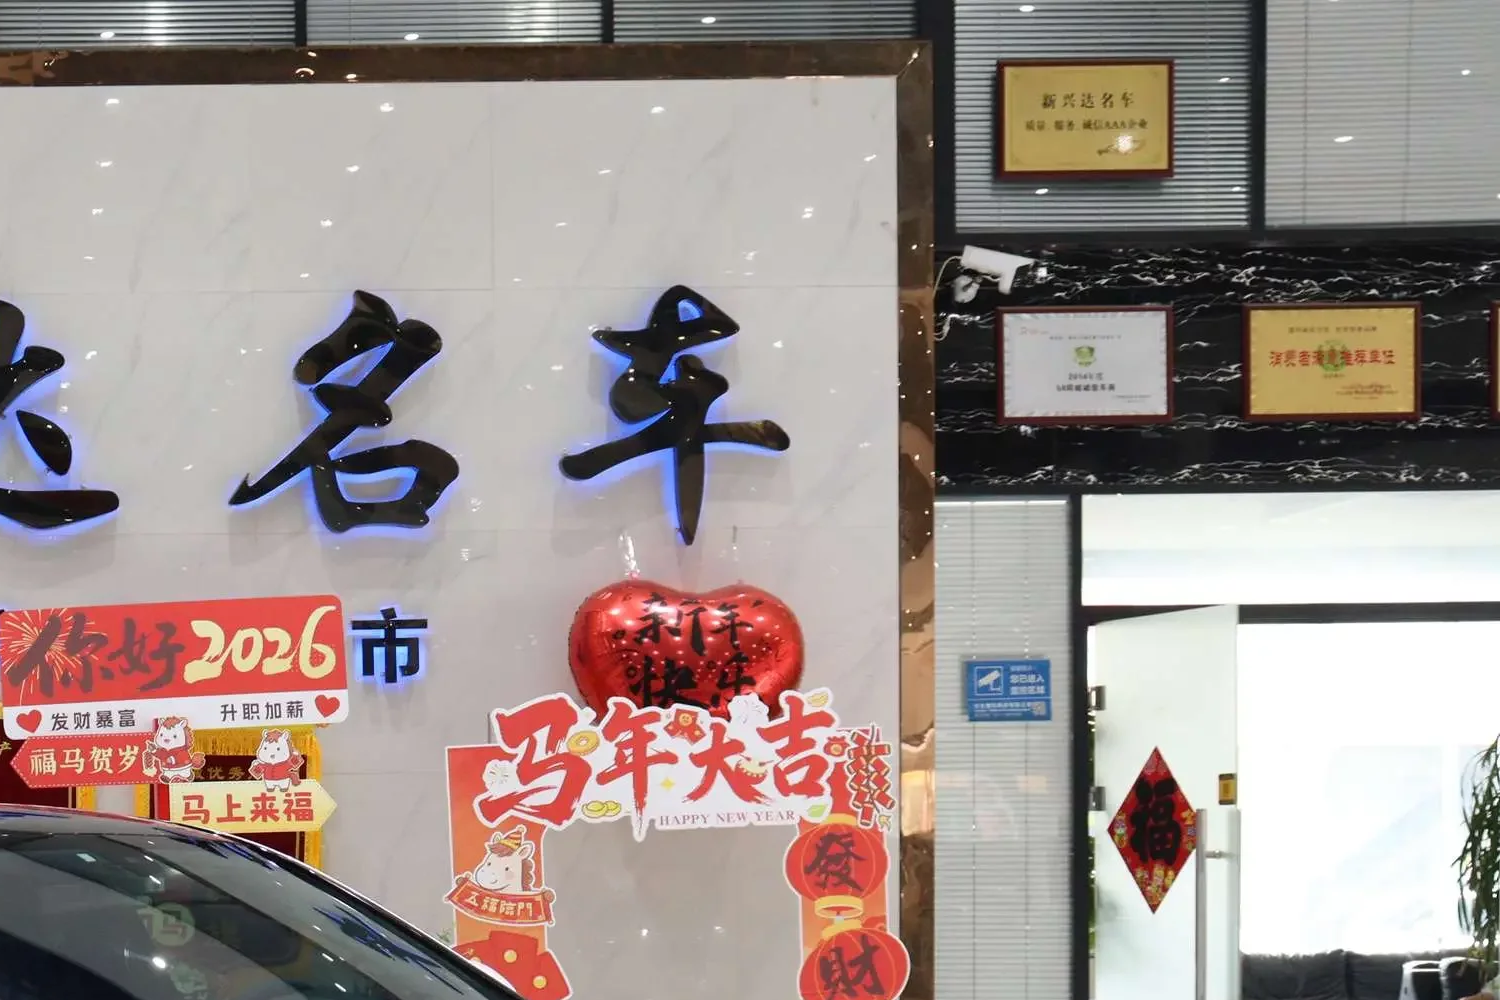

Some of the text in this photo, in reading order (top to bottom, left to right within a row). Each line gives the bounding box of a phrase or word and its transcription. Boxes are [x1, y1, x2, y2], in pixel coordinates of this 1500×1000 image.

[1041, 91, 1134, 109] 新兴达名车
[634, 592, 753, 656] 新年
[51, 700, 304, 731] 发财暴富 升职加薪
[30, 743, 140, 776] 福马贺岁
[481, 695, 837, 826] 马年大吉
[182, 792, 314, 824] 马上来福
[659, 810, 796, 826] HAPPY NEW YEAR
